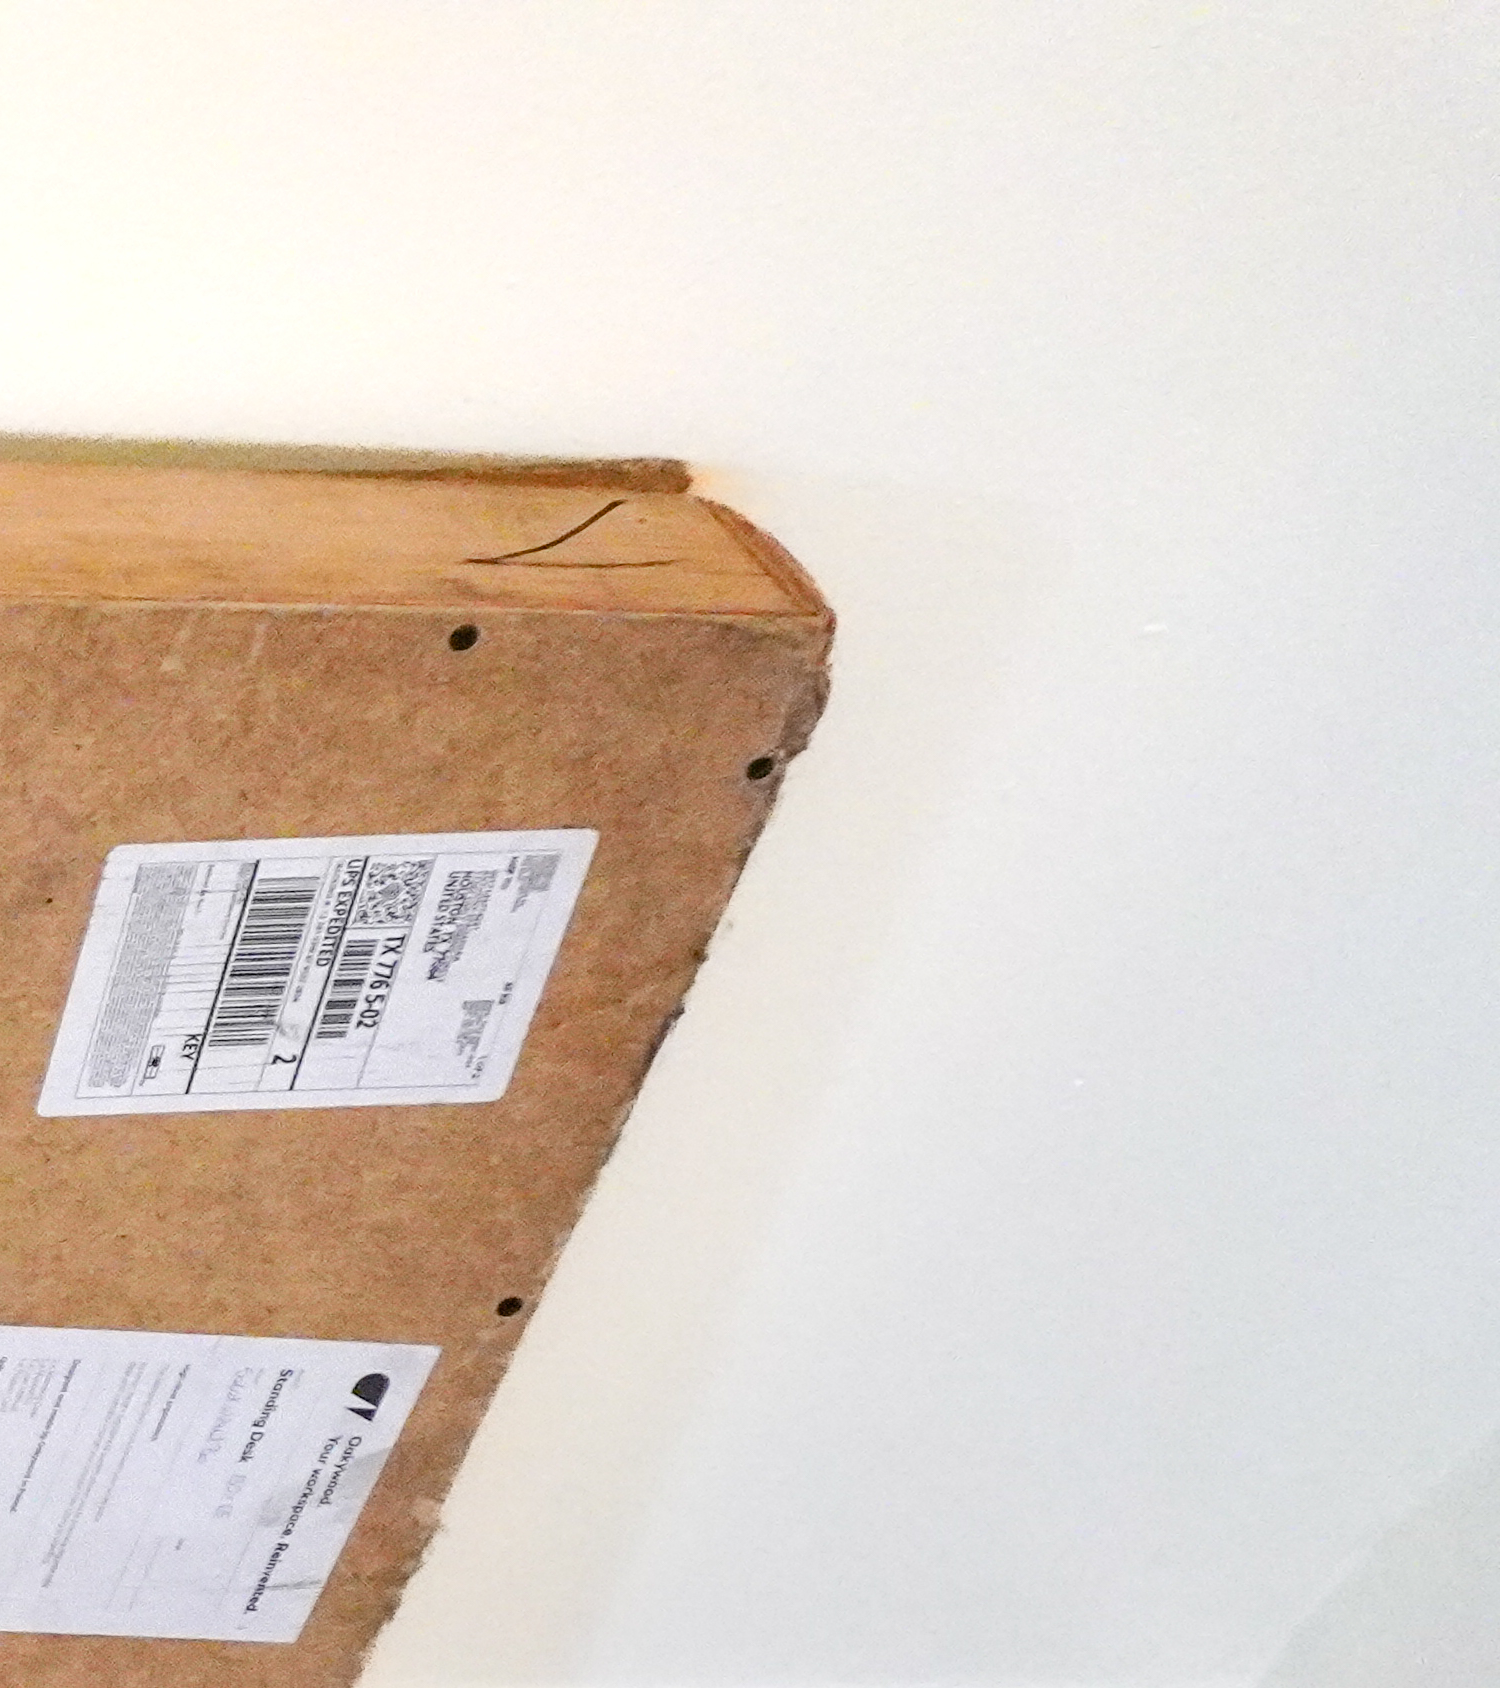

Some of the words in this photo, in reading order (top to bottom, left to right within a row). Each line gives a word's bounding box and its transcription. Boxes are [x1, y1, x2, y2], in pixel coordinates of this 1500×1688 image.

[340, 858, 363, 886] UPS
[436, 871, 462, 911] UNITED
[445, 871, 474, 924] HOUSTON
[314, 891, 352, 967] EXPEDITED
[379, 936, 404, 955] TX
[422, 915, 447, 953] STATES
[368, 961, 396, 989] 776
[355, 994, 385, 1029] 5-02
[178, 1033, 201, 1060] KEY
[270, 1053, 298, 1065] 2
[250, 1368, 295, 1428] Standing
[236, 1431, 265, 1463] Desk
[315, 1436, 343, 1464] Your
[314, 1435, 364, 1507] Oakywood.
[277, 1468, 325, 1539] workspace.
[242, 1542, 290, 1614] Reinvented.
